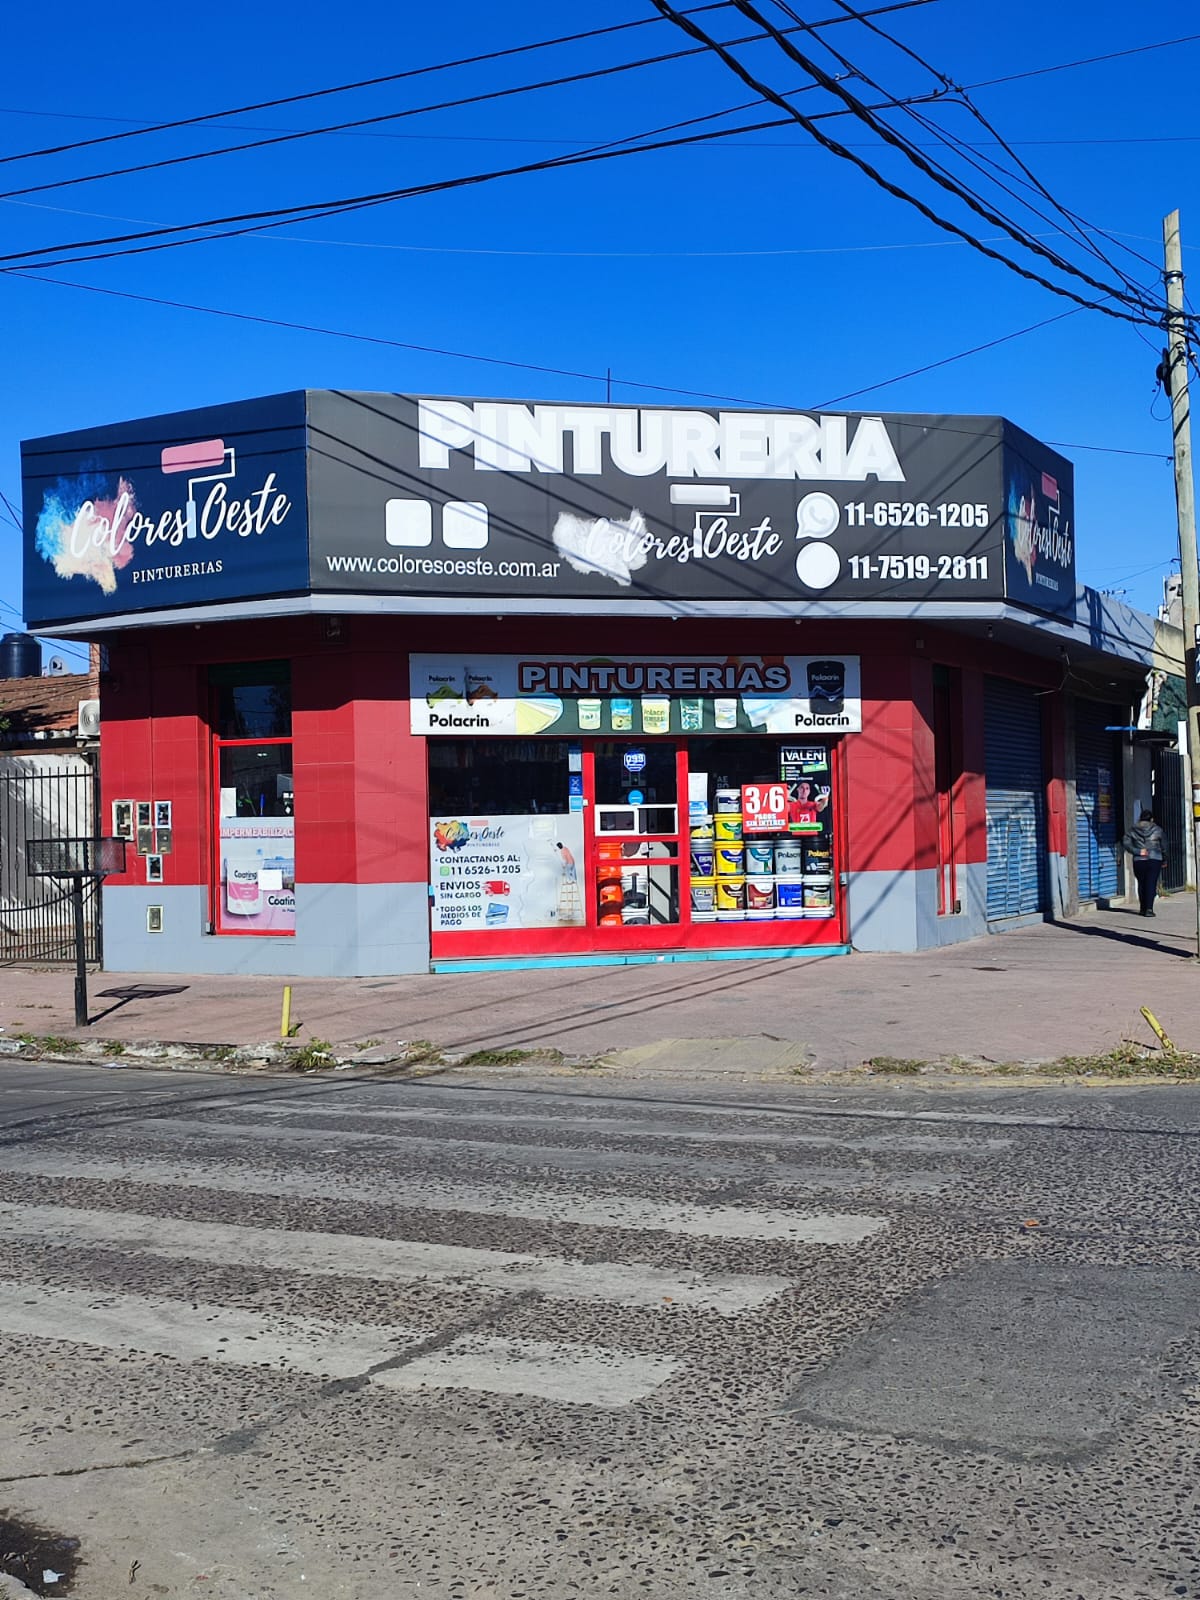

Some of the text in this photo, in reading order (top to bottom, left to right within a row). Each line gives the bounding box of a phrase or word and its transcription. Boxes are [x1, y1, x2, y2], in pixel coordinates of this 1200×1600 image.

[418, 399, 906, 483] PINTURERIA
[70, 473, 291, 560] Colores Oeste
[844, 502, 990, 529] 11-6526-1205
[585, 515, 784, 563] Colores Oeste
[132, 560, 224, 584] PINTURERIAS
[326, 554, 561, 578] www.coloresoeste.com.ar
[848, 555, 990, 581] 11-7519-2811
[520, 664, 790, 692] PINTURERIAS
[429, 713, 490, 728] Polacrin
[795, 713, 850, 727] Polacrin
[745, 786, 785, 814] 3/6
[439, 854, 521, 865] CONTACTANOS AL:
[440, 881, 481, 891] ENVIOS
[440, 891, 482, 900] SIN CARGO
